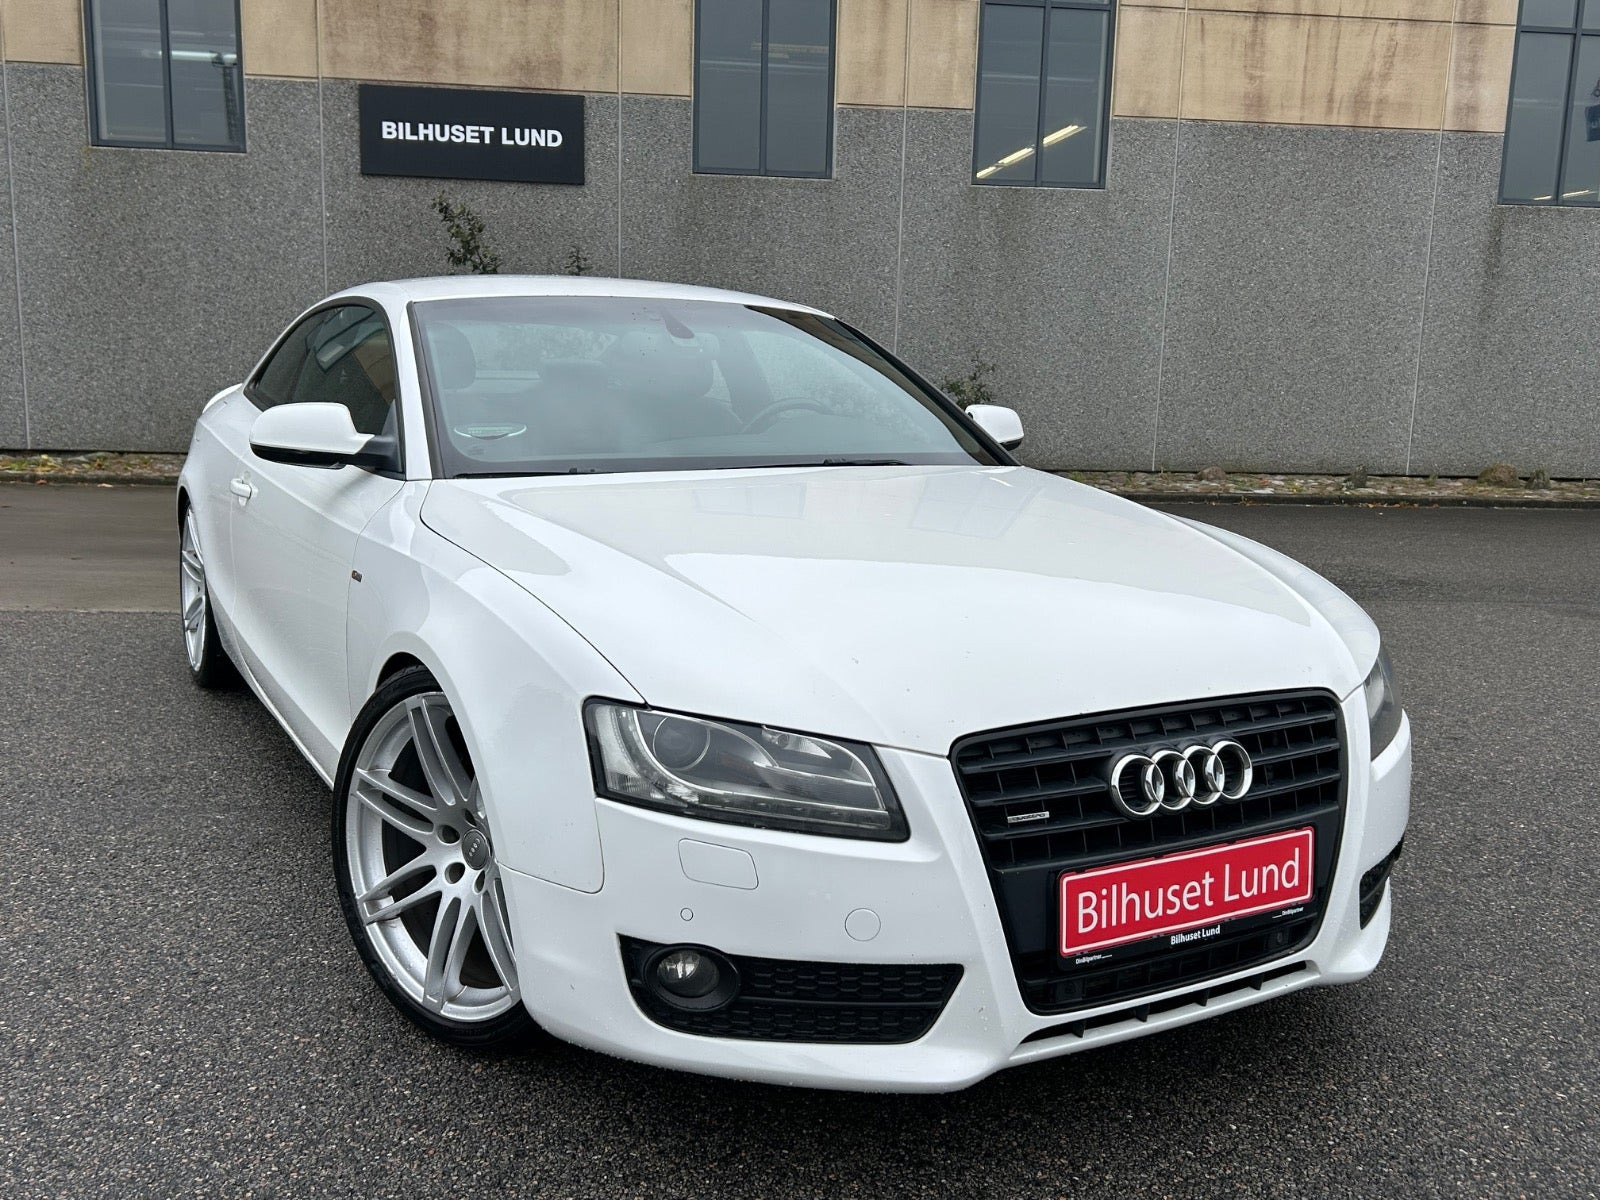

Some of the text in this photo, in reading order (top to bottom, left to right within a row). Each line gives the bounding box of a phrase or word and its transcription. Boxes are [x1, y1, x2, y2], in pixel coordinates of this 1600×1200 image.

[381, 121, 563, 147] BILHUSET LUND
[1077, 847, 1300, 934] Bilhuset Lund
[1170, 924, 1221, 945] Bilhuset Lund
